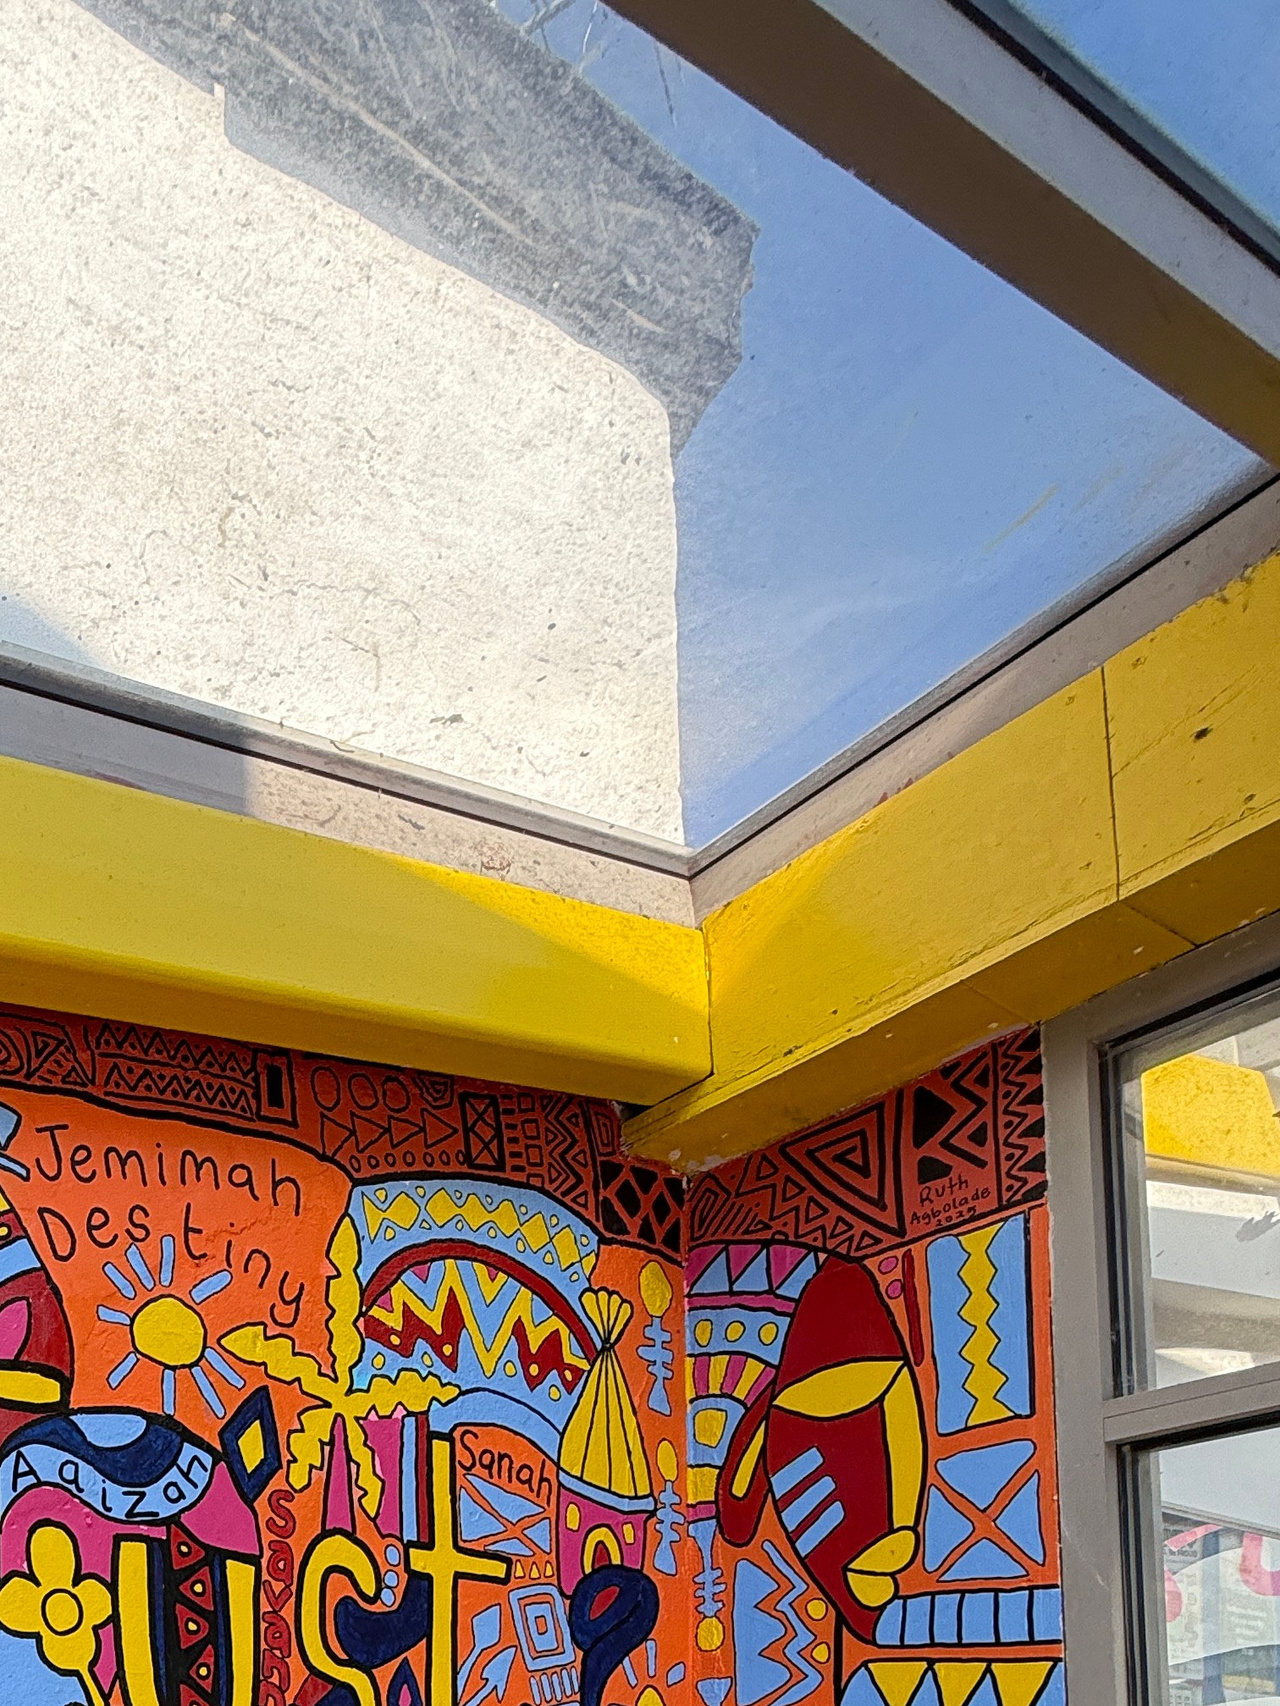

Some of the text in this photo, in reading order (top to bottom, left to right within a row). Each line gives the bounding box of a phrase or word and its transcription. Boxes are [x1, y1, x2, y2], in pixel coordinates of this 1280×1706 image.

[34, 1124, 301, 1219] Jemimah
[920, 1173, 968, 1207] Ruth
[910, 1187, 991, 1225] Agbolade
[936, 1205, 976, 1226] 2025
[39, 1205, 306, 1328] Destiny
[12, 1449, 208, 1517] Aaizah
[458, 1429, 552, 1506] Sanah
